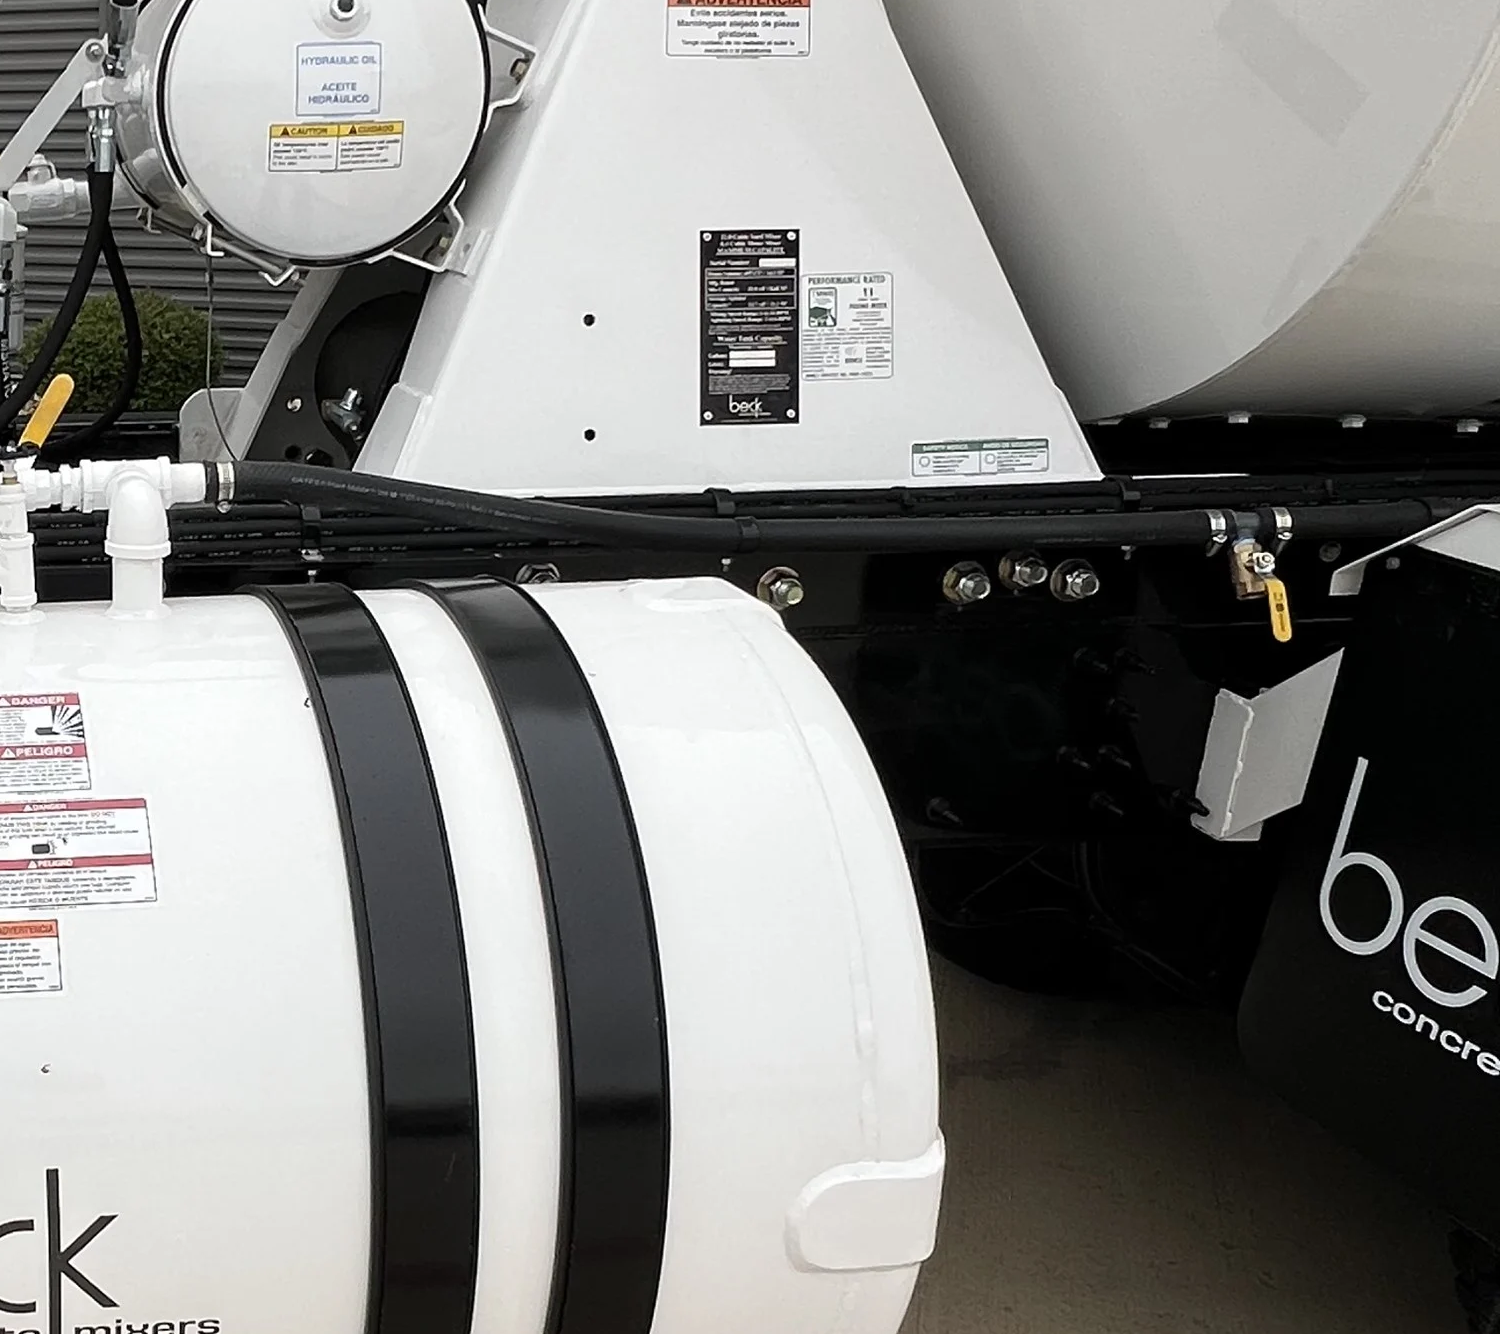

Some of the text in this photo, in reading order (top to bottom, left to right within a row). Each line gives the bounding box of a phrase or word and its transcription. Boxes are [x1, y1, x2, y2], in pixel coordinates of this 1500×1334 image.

[301, 55, 377, 66] HYDRAULIC OIL
[321, 82, 357, 91] ACEITE
[729, 395, 762, 418] beck
[11, 696, 65, 706] DANGER
[16, 746, 73, 756] PELIGRO
[37, 859, 73, 867] PELIGRO
